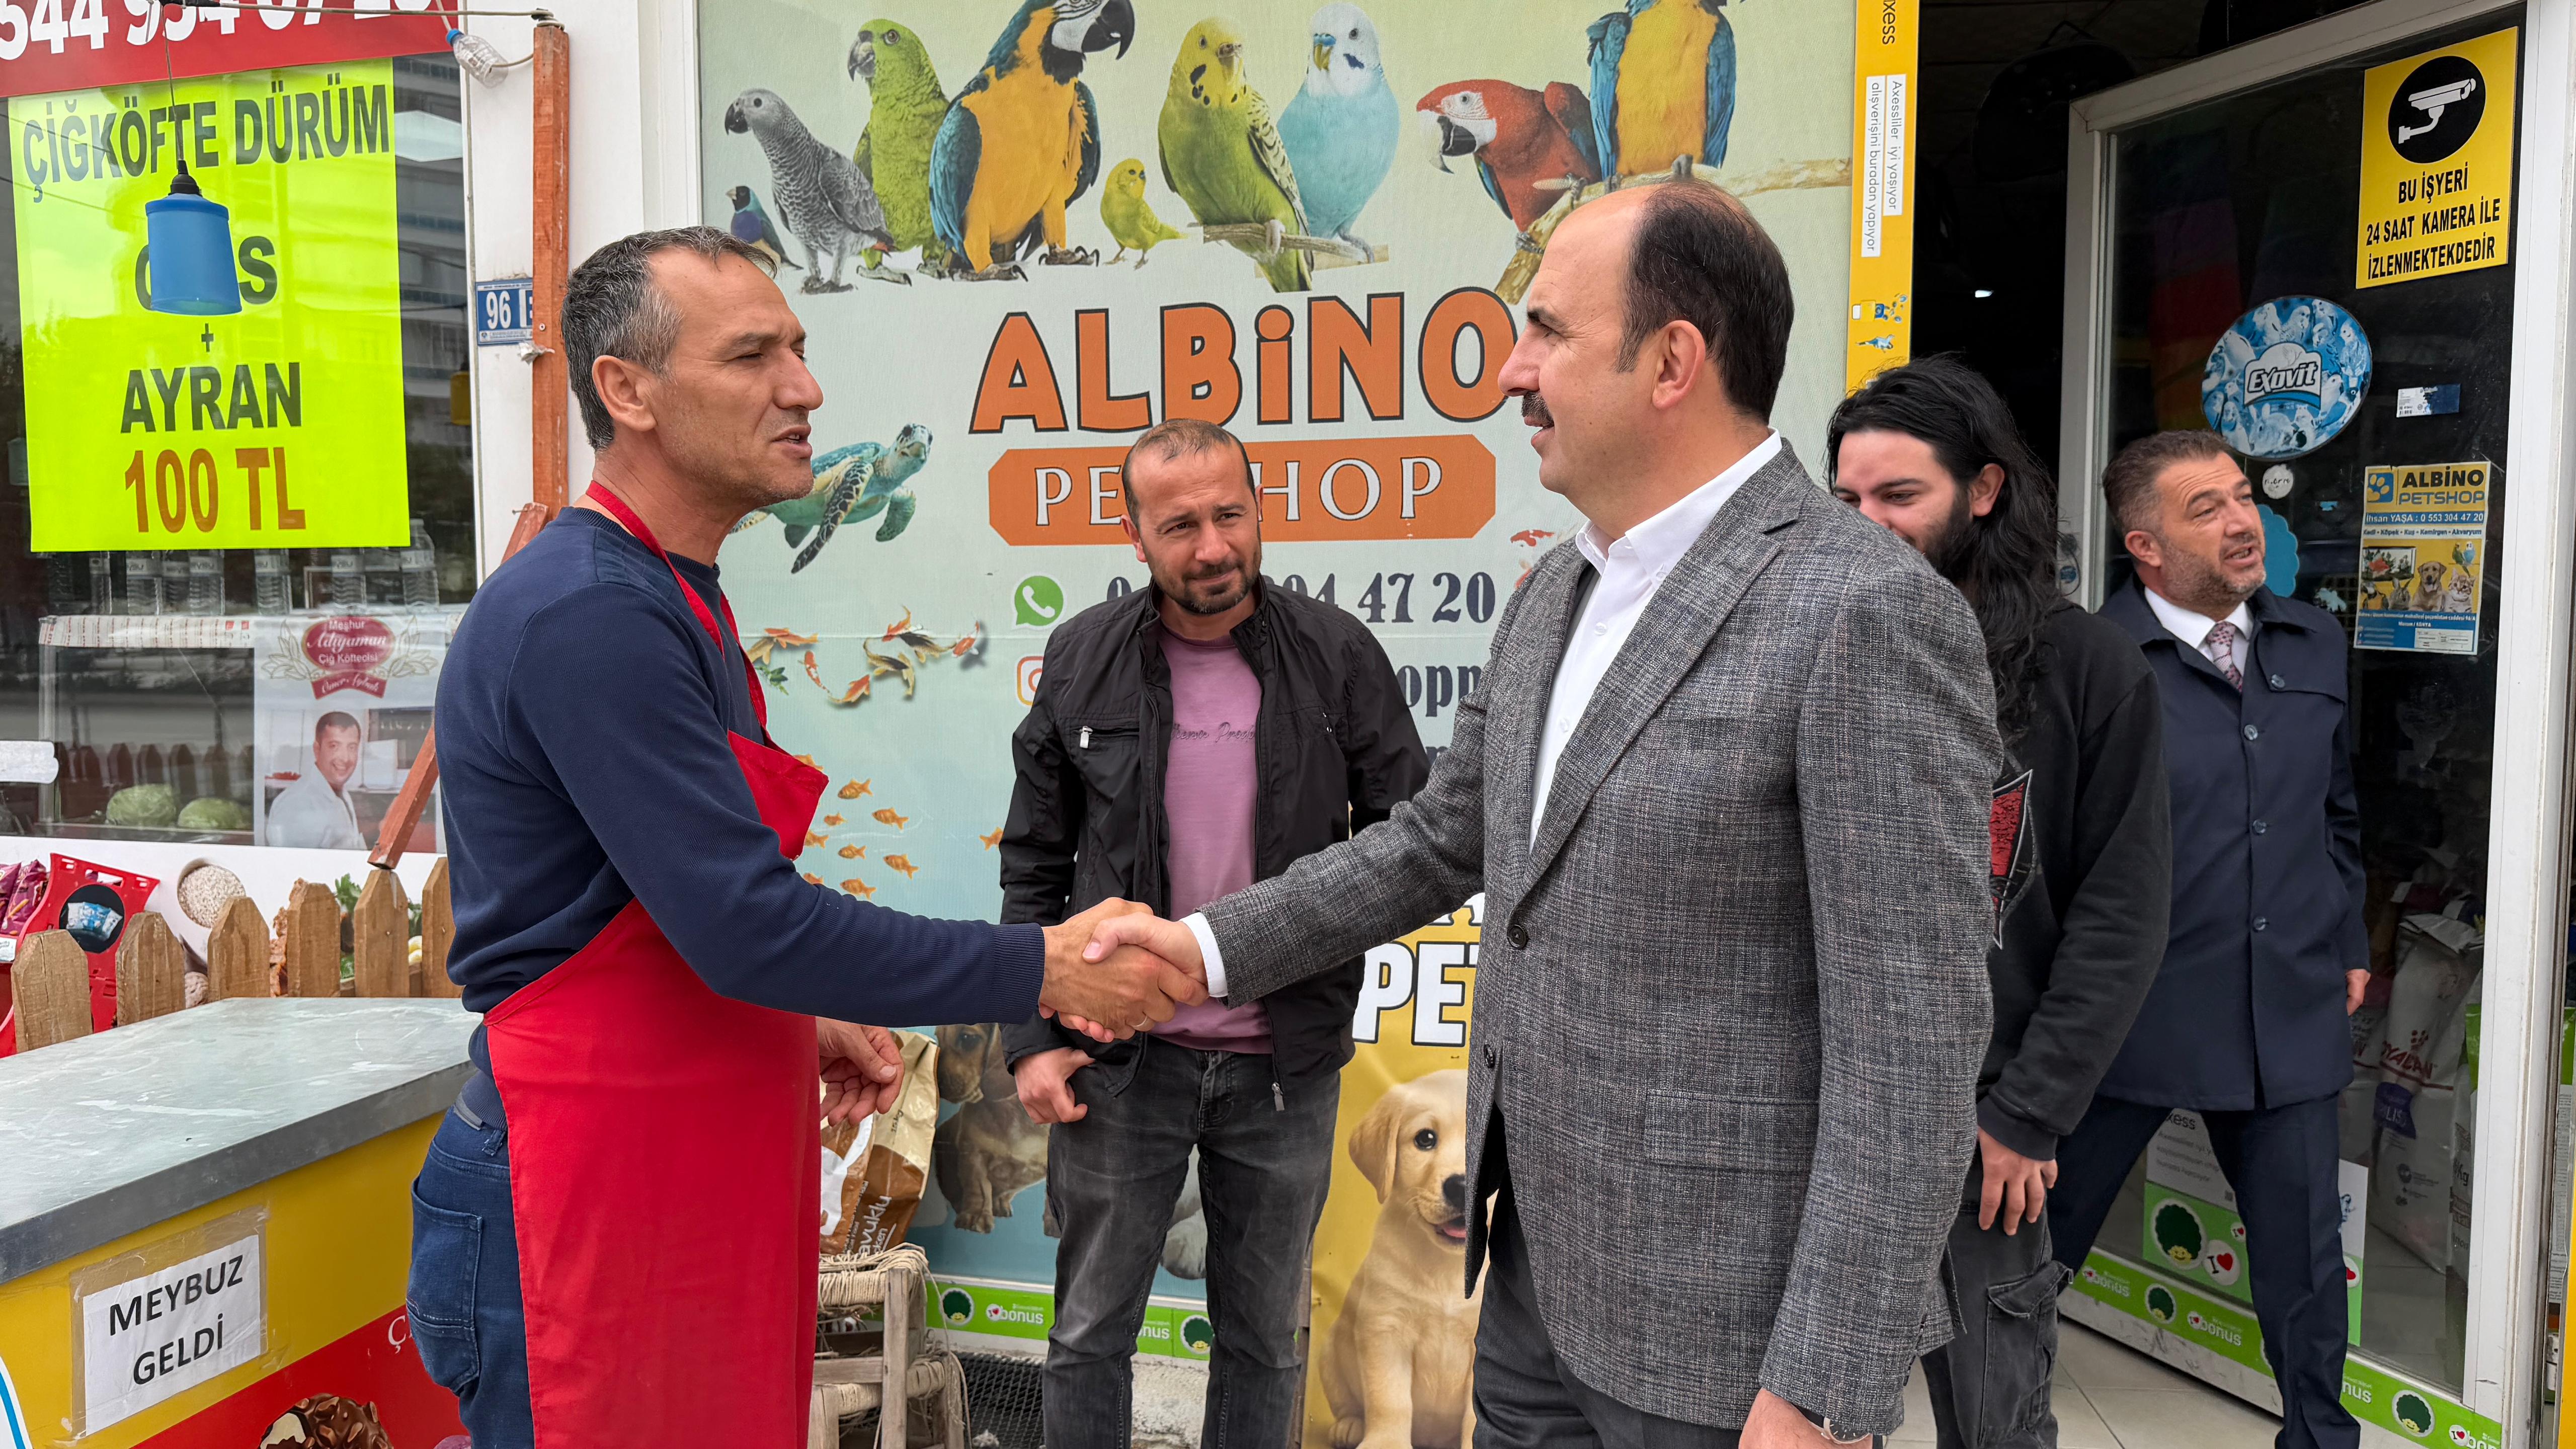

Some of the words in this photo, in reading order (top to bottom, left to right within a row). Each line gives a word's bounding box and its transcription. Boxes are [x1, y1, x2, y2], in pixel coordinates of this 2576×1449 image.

[1869, 83, 1882, 147] alışverişini
[1891, 81, 1902, 139] Axessliler
[23, 97, 219, 203] ÇİĞKÖFTE
[235, 72, 389, 165] DÜRÜM
[1887, 146, 1901, 160] iyi
[1867, 150, 1880, 201] buradan
[1887, 164, 1897, 210] yaşıyor
[2398, 179, 2417, 204] BU
[2421, 161, 2468, 204] İŞYERİ
[1864, 203, 1876, 251] yapıyor
[2366, 222, 2380, 246] 24
[2383, 216, 2414, 243] SAAT
[2422, 202, 2475, 235] KAMERA
[2479, 196, 2500, 224] İLE
[2368, 232, 2496, 280] İZLENMEKTEKDEDİR
[486, 291, 512, 330] 96
[120, 362, 302, 433] AYRAN
[2247, 361, 2318, 393] Exovit
[125, 448, 219, 533] 100
[235, 447, 306, 530] TL
[1034, 456, 1443, 527] PEHOP
[2398, 491, 2484, 505] PETSHOP
[2402, 466, 2484, 488] ALBİNO
[2390, 514, 2413, 524] YAŞA
[2445, 513, 2458, 521] 304
[2473, 513, 2483, 521] 20
[1357, 573, 1415, 623] 47
[1432, 571, 1496, 624] 20
[329, 620, 366, 632] Meşhur
[1352, 941, 1479, 1048] PE
[858, 1195, 892, 1255] avuklu
[109, 1255, 244, 1336] MEYBUZ
[1000, 1306, 1044, 1324] bonus
[133, 1313, 224, 1385] GELDİ
[2200, 1319, 2242, 1346] bonus
